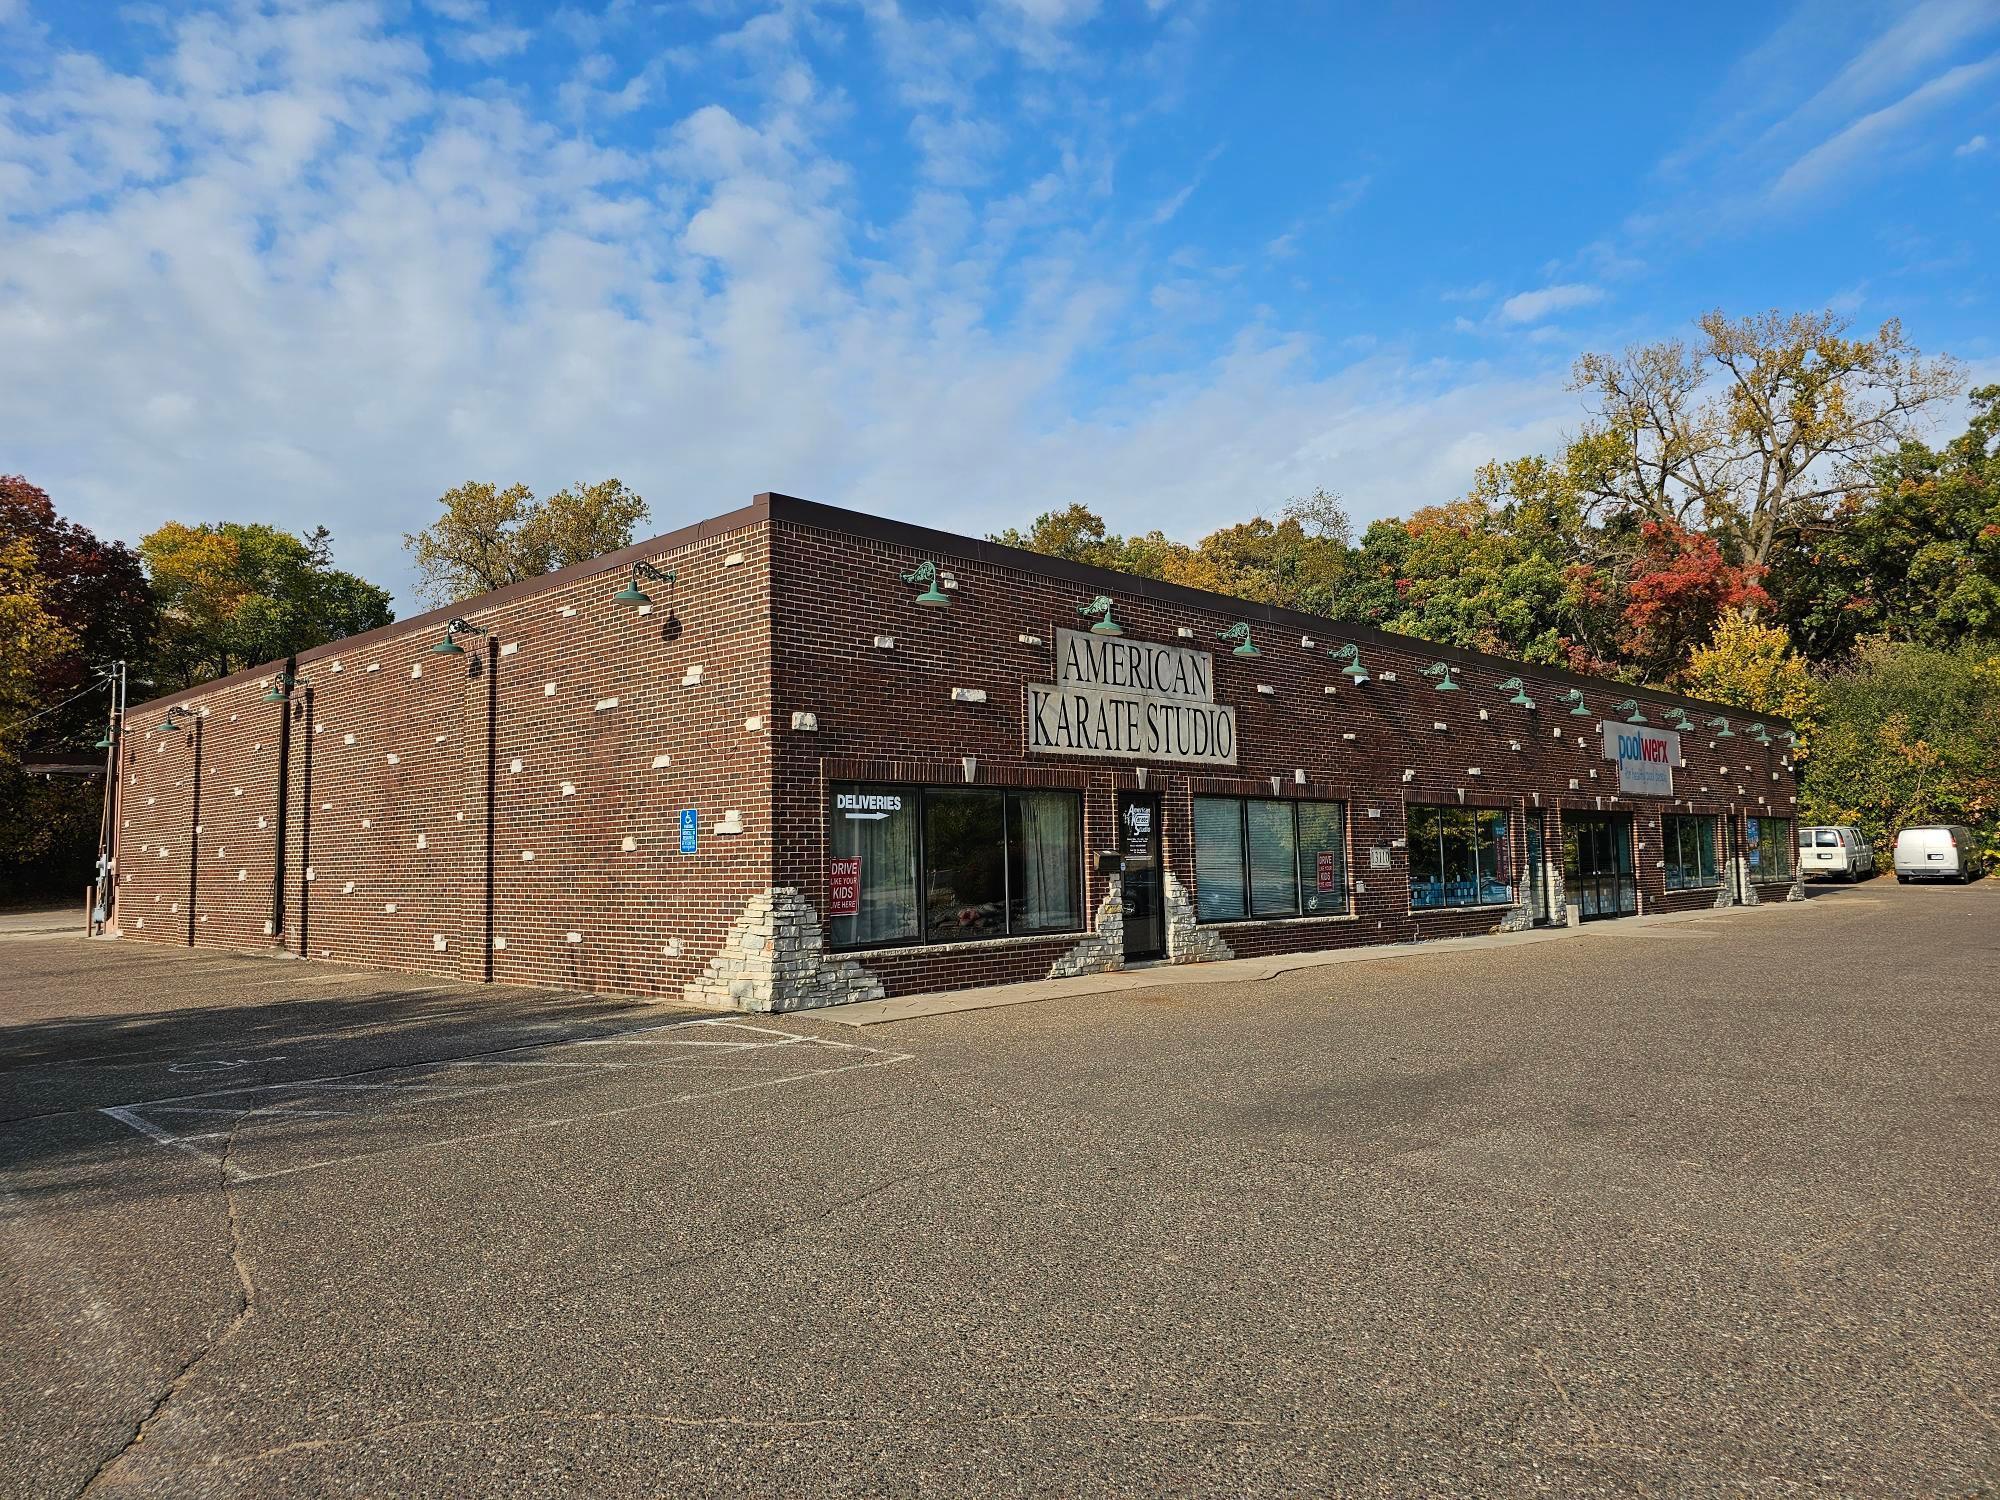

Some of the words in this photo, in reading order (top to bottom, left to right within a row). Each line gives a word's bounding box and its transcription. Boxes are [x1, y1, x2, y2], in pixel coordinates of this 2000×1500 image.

[1063, 636, 1207, 696] AMERICAN
[1032, 691, 1141, 751] KARATE
[1147, 703, 1232, 758] STUDIO
[1618, 730, 1669, 771] poolwerx
[837, 794, 902, 811] DELIVERIES
[1127, 804, 1151, 817] American
[831, 862, 858, 875] DRIVE
[843, 877, 858, 885] YOUR
[833, 886, 853, 899] KIDS
[841, 900, 856, 908] HERE
